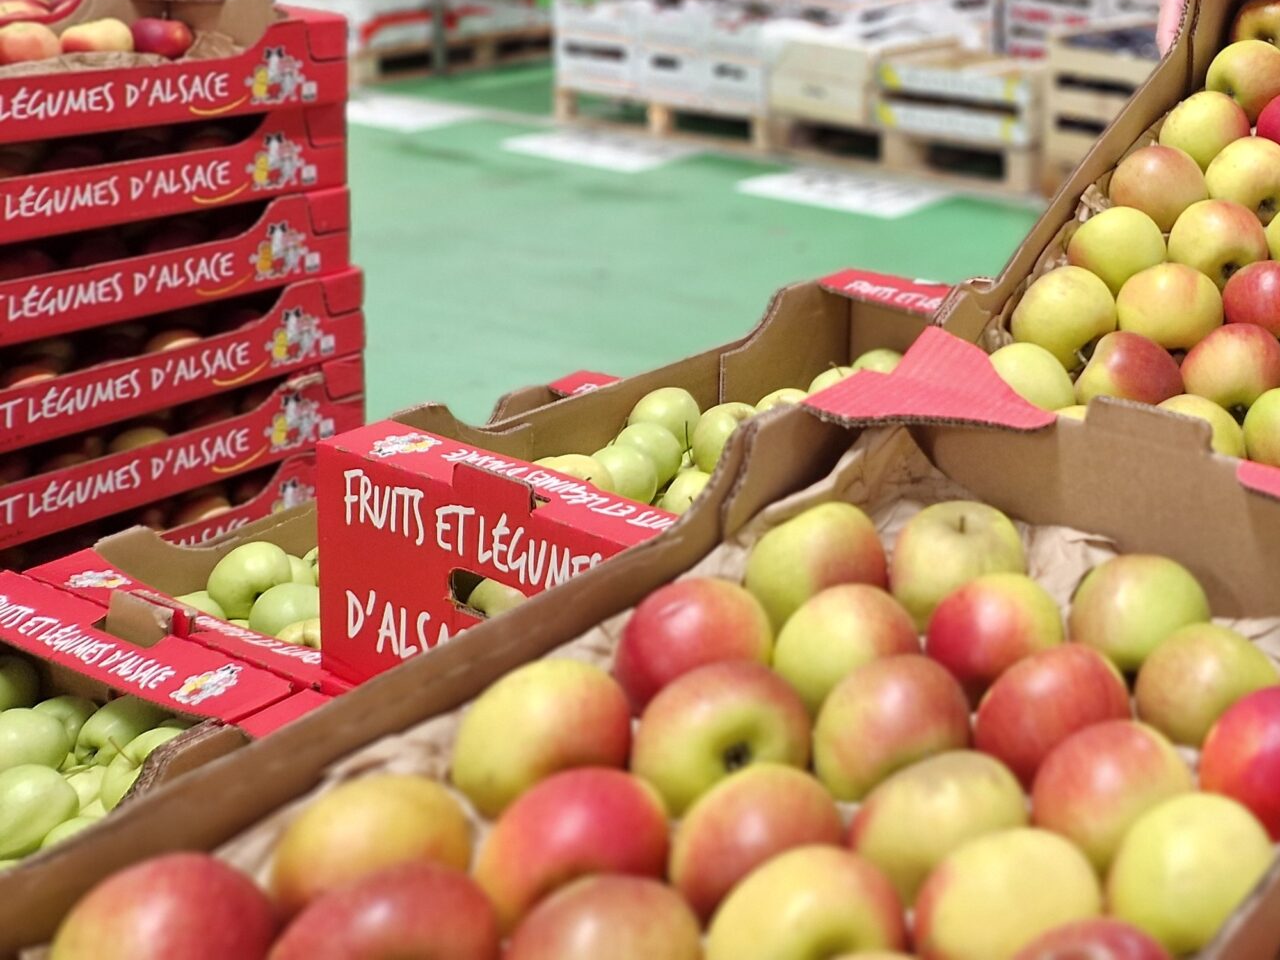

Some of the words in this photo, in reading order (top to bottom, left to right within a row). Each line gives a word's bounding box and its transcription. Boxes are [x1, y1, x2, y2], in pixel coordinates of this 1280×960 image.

[0, 81, 115, 122] LÉGUMES
[125, 72, 229, 109] D'ALSACE
[5, 176, 120, 221] LÉGUMES
[130, 161, 232, 201] D'ALSACE
[7, 272, 123, 321] LÉGUMES
[133, 252, 234, 296] D'ALSACE
[27, 369, 141, 423] LÉGUMES
[151, 342, 250, 391] D'ALSACE
[27, 459, 141, 519] LÉGUMES
[151, 428, 250, 481] D'ALSACE
[602, 501, 637, 518] ET
[343, 468, 425, 546] FRUITS
[435, 504, 476, 557] ET
[17, 615, 60, 637] ET
[97, 649, 177, 690] D'ALSACE
